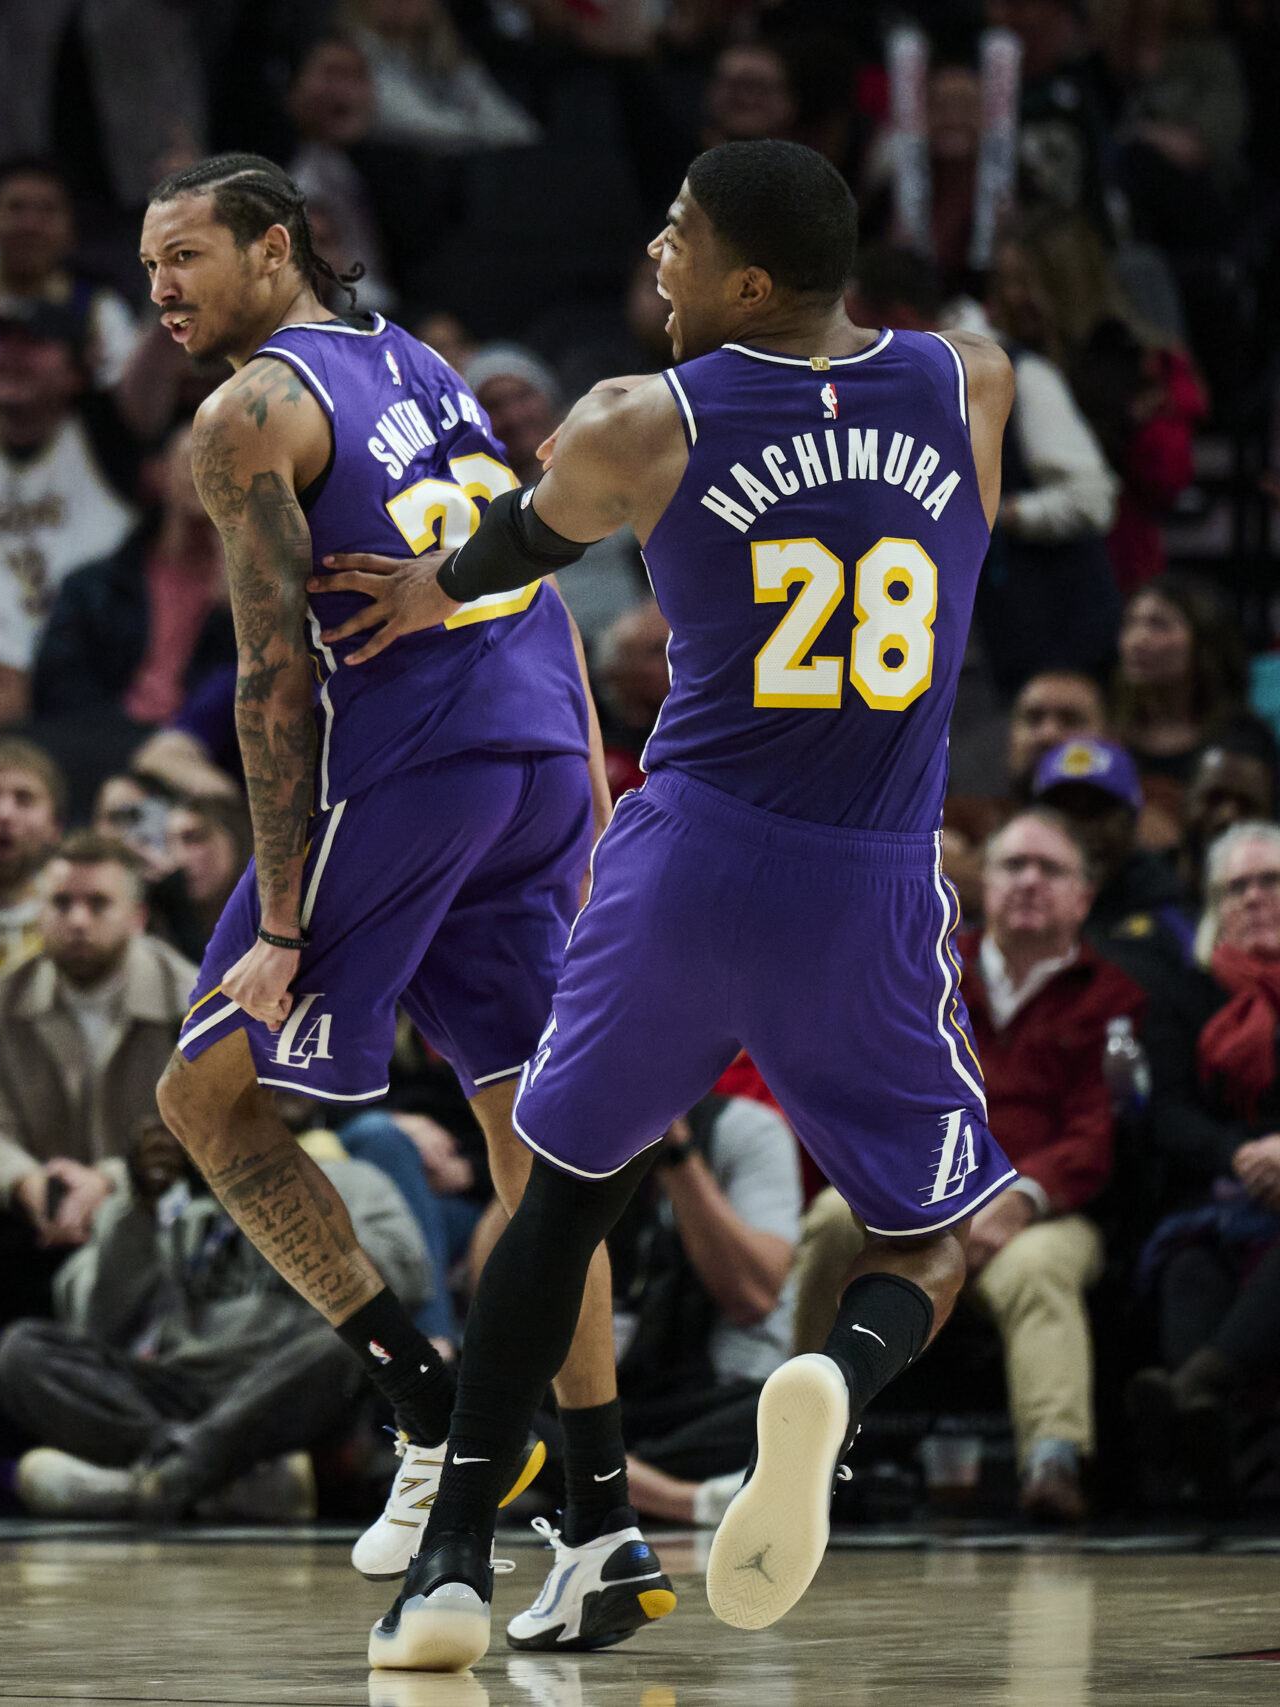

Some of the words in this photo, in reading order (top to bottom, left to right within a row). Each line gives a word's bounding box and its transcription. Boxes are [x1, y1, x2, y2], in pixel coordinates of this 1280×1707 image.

[367, 399, 438, 480] SMITH
[439, 392, 488, 437] JR.
[700, 428, 962, 534] HACHIMURA
[750, 536, 938, 712] 28
[268, 992, 334, 1069] LA
[919, 1107, 980, 1206] LA
